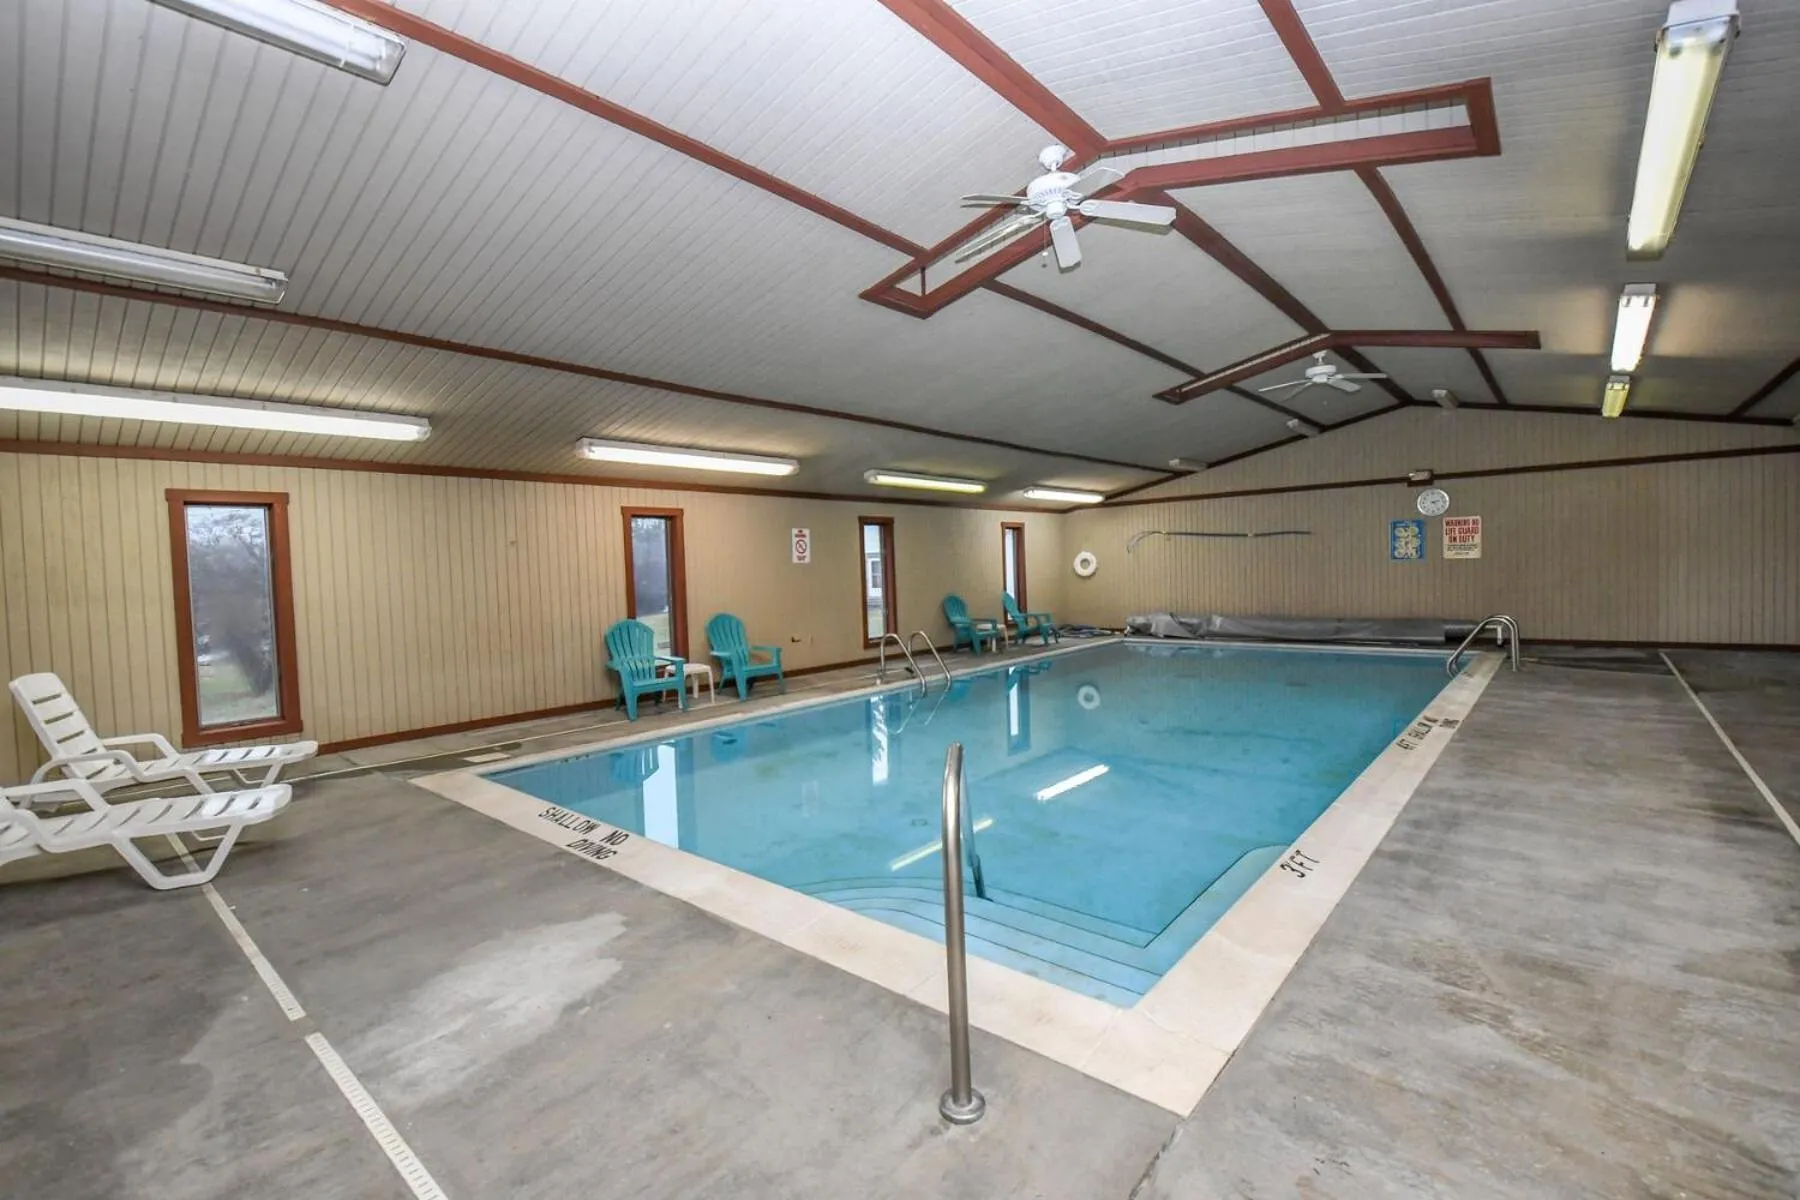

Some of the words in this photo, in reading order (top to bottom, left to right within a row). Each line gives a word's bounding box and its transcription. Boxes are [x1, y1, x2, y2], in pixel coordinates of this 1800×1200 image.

[1458, 527, 1479, 535] GUARD
[1459, 535, 1475, 543] DUTY
[538, 806, 600, 835] SHALLOW
[600, 830, 629, 846] NO
[566, 838, 618, 860] DIVING
